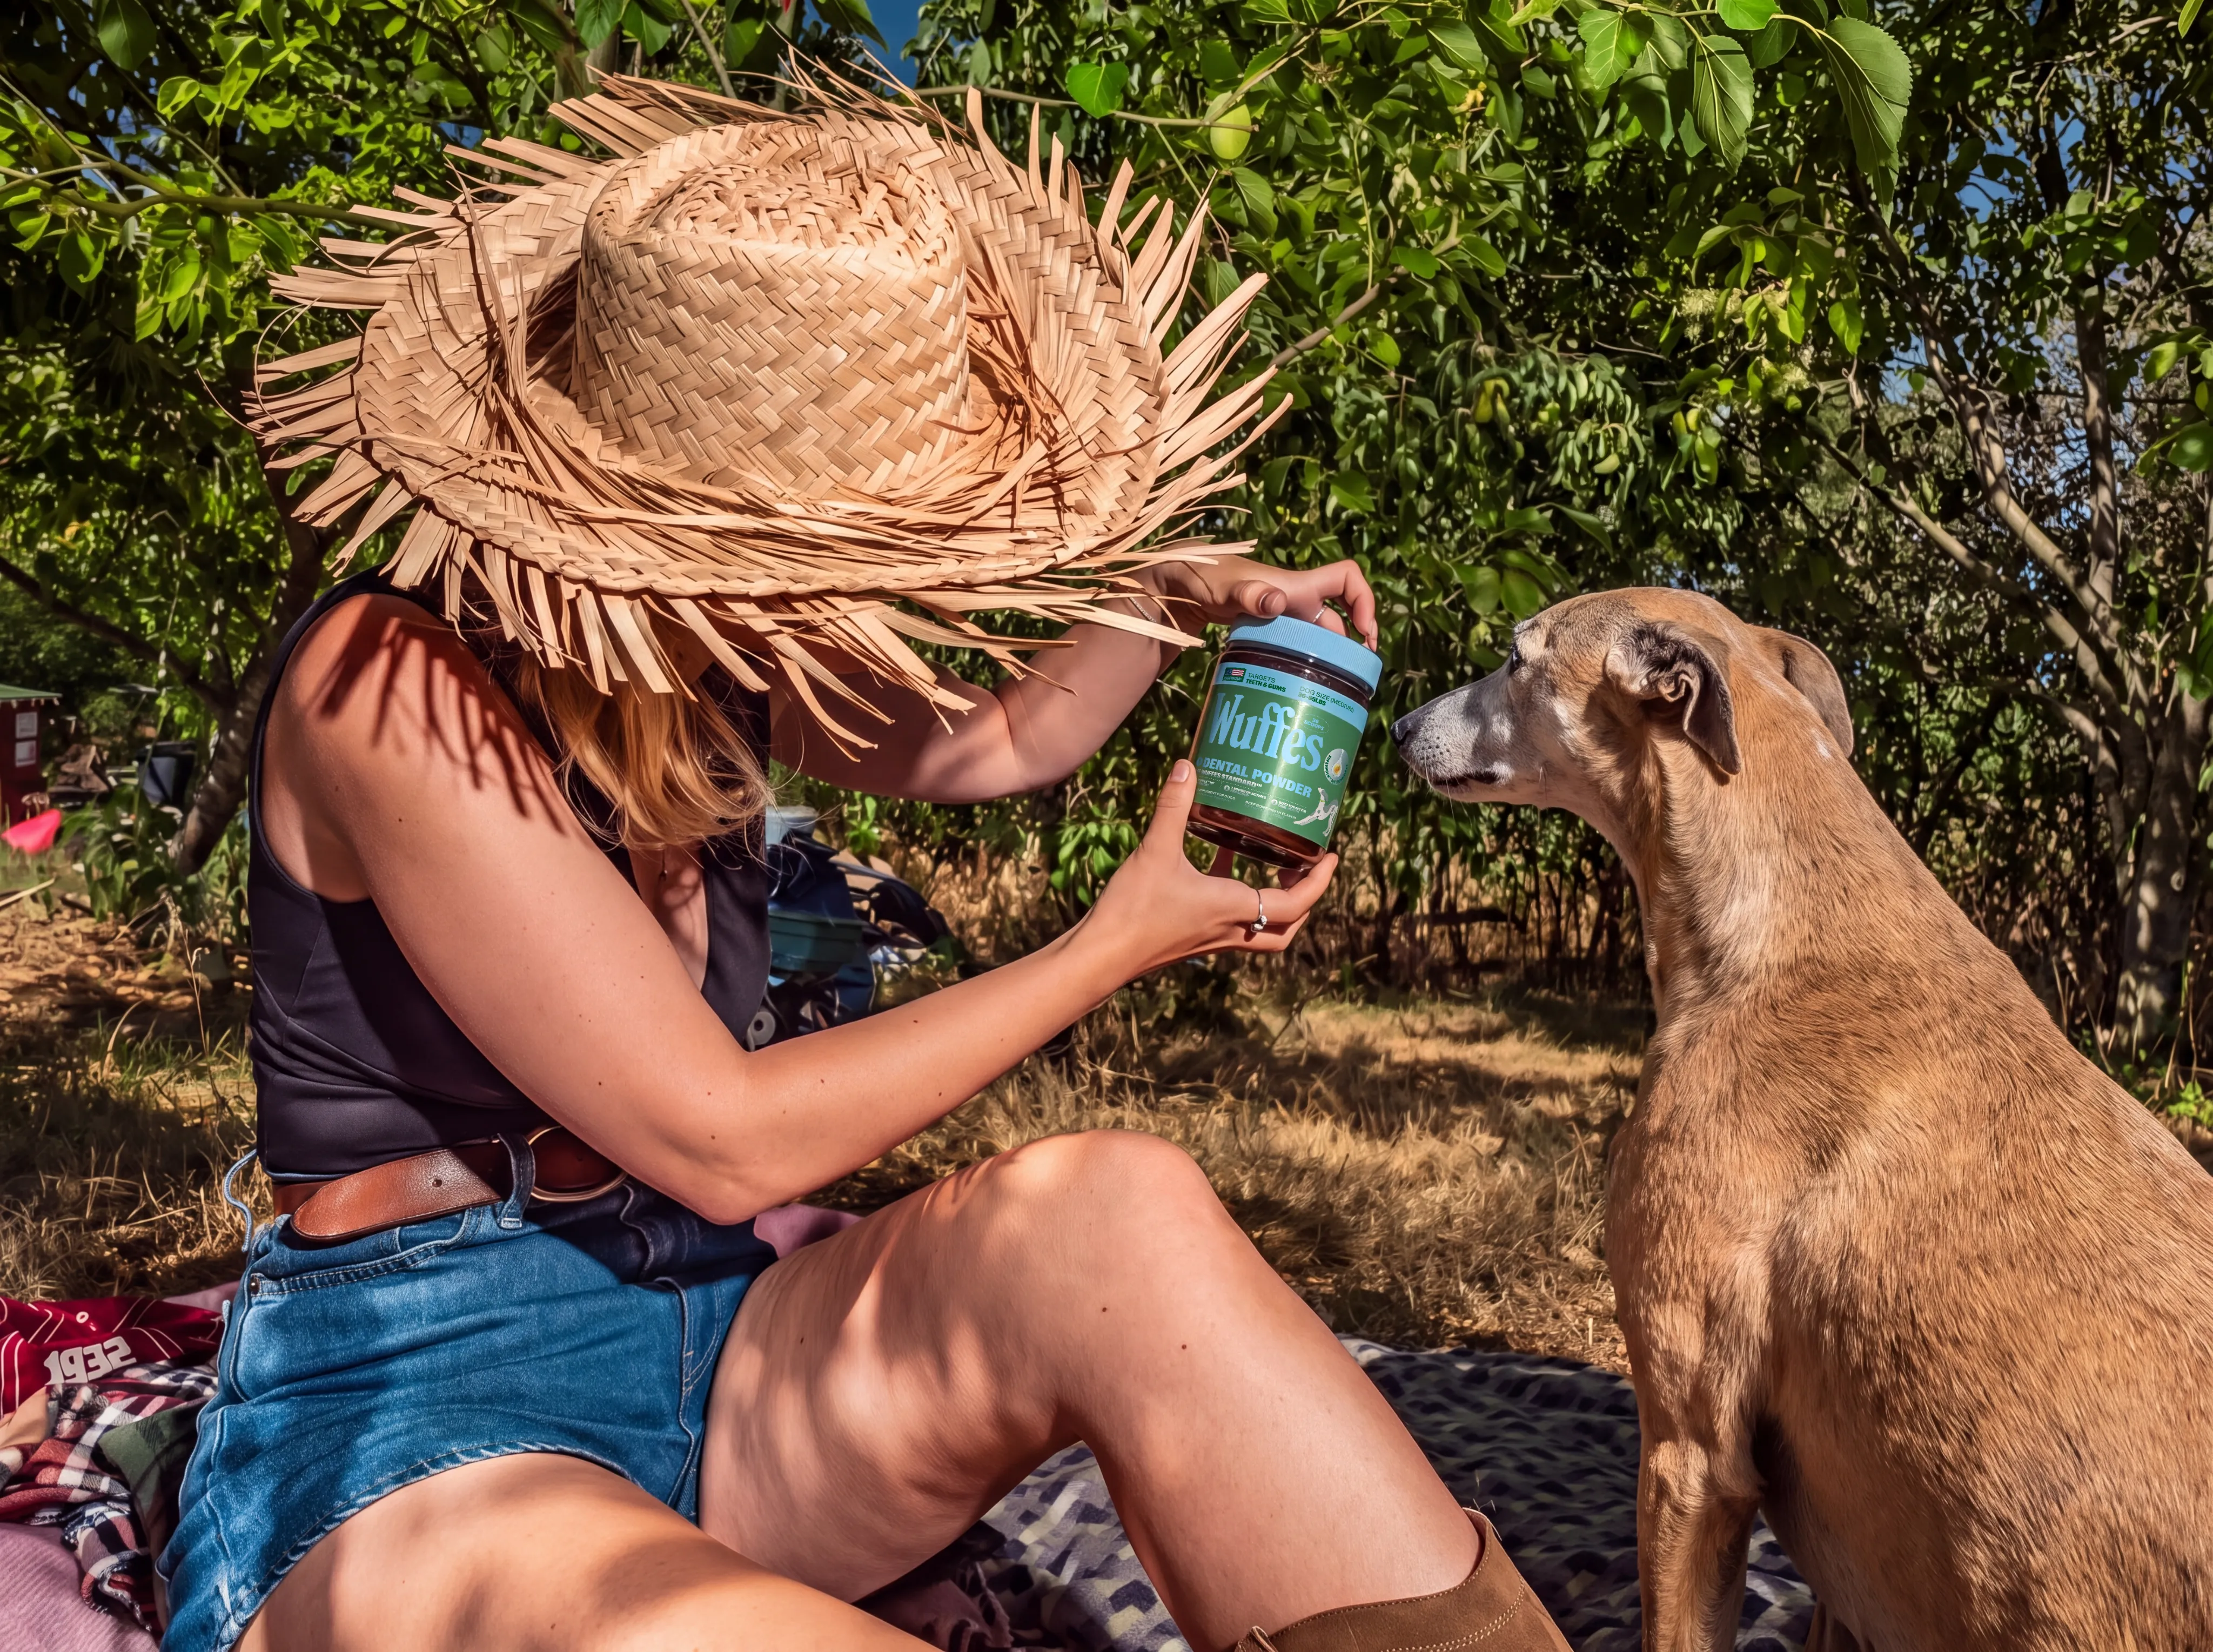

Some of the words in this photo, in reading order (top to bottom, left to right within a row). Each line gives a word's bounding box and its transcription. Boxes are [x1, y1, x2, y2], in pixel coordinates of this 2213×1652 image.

[1248, 673, 1276, 683] TARGETS
[1268, 684, 1286, 692] GUMS
[1299, 686, 1315, 695] DOG
[1316, 692, 1330, 701] SIZE
[1330, 698, 1354, 713] (MEDIUM)
[1304, 720, 1324, 730] SCOOPS
[1209, 693, 1323, 771] Wuffes
[1202, 769, 1221, 778] WUFFES
[1203, 757, 1248, 778] DENTAL
[1251, 769, 1312, 798] POWDER
[1282, 811, 1297, 820] FLAVOR
[44, 1336, 137, 1386] 1932
